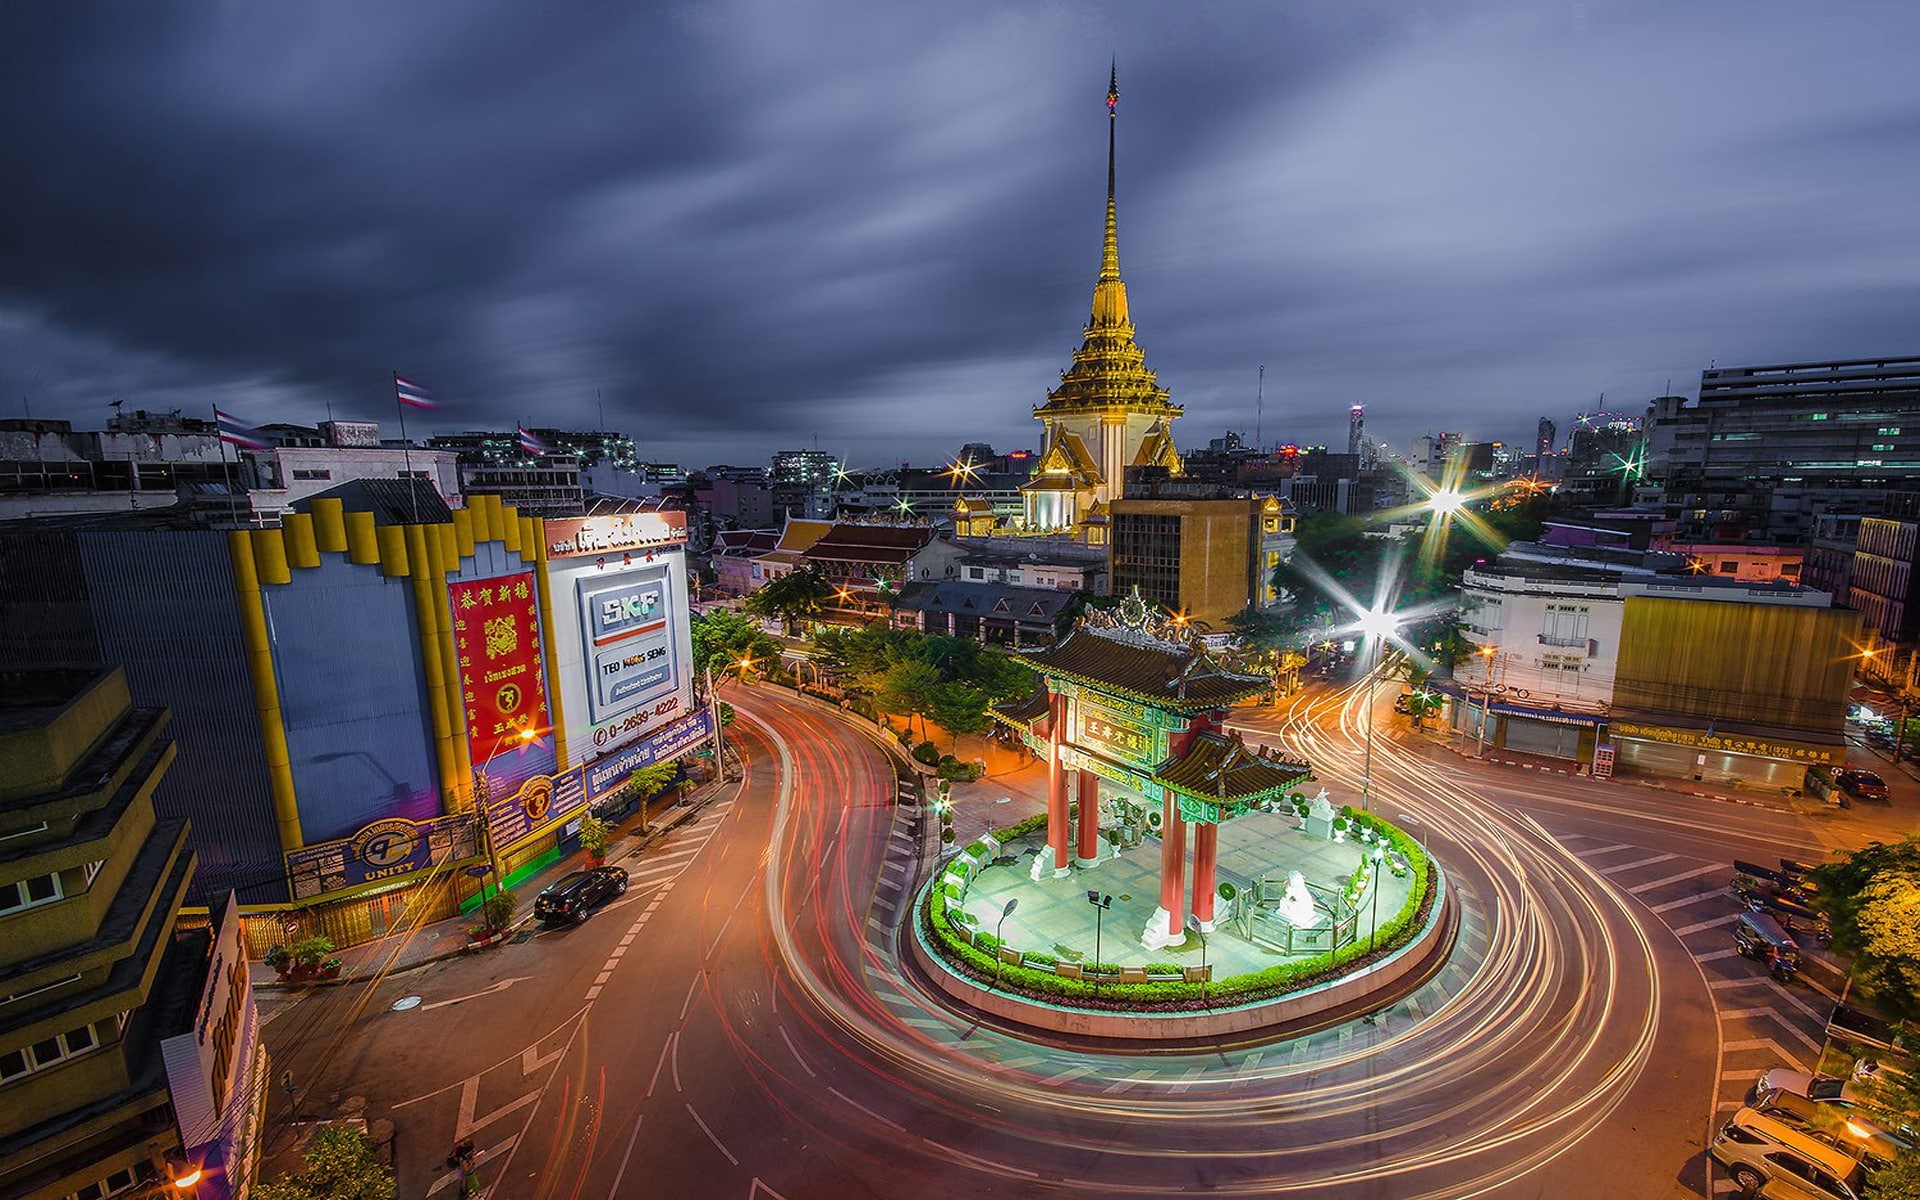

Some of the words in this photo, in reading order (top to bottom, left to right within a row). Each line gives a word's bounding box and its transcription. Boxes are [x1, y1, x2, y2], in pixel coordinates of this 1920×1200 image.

[460, 581, 530, 610] 恭賀新禧
[602, 590, 659, 626] SKF
[602, 662, 620, 676] TEO
[647, 646, 666, 661] SENG
[609, 697, 679, 738] 0-2639-4222
[364, 862, 415, 881] UNITY
